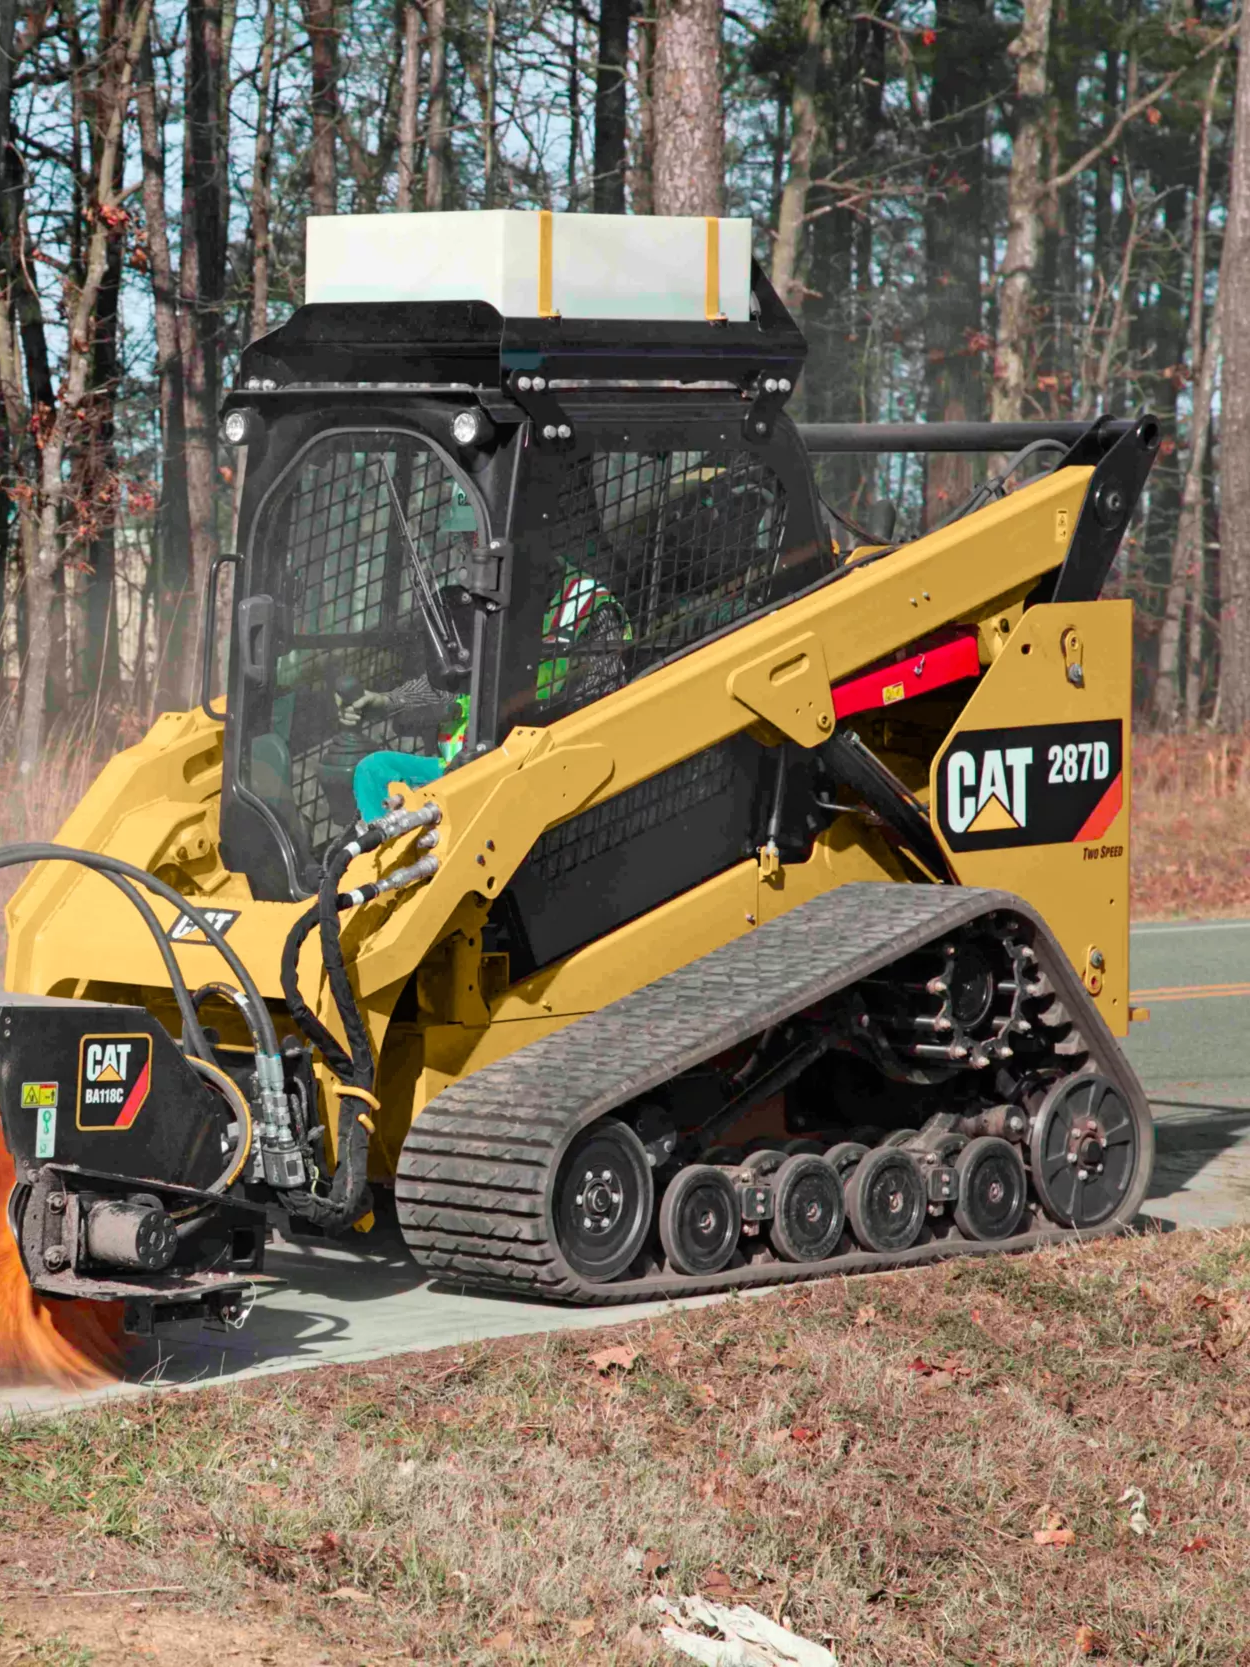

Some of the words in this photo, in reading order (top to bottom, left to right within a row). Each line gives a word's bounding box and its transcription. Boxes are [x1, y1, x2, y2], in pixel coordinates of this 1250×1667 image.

[947, 747, 1033, 833] CAT
[1048, 741, 1110, 784] 287D
[86, 1043, 132, 1082] CAT
[85, 1088, 124, 1104] BA118C
